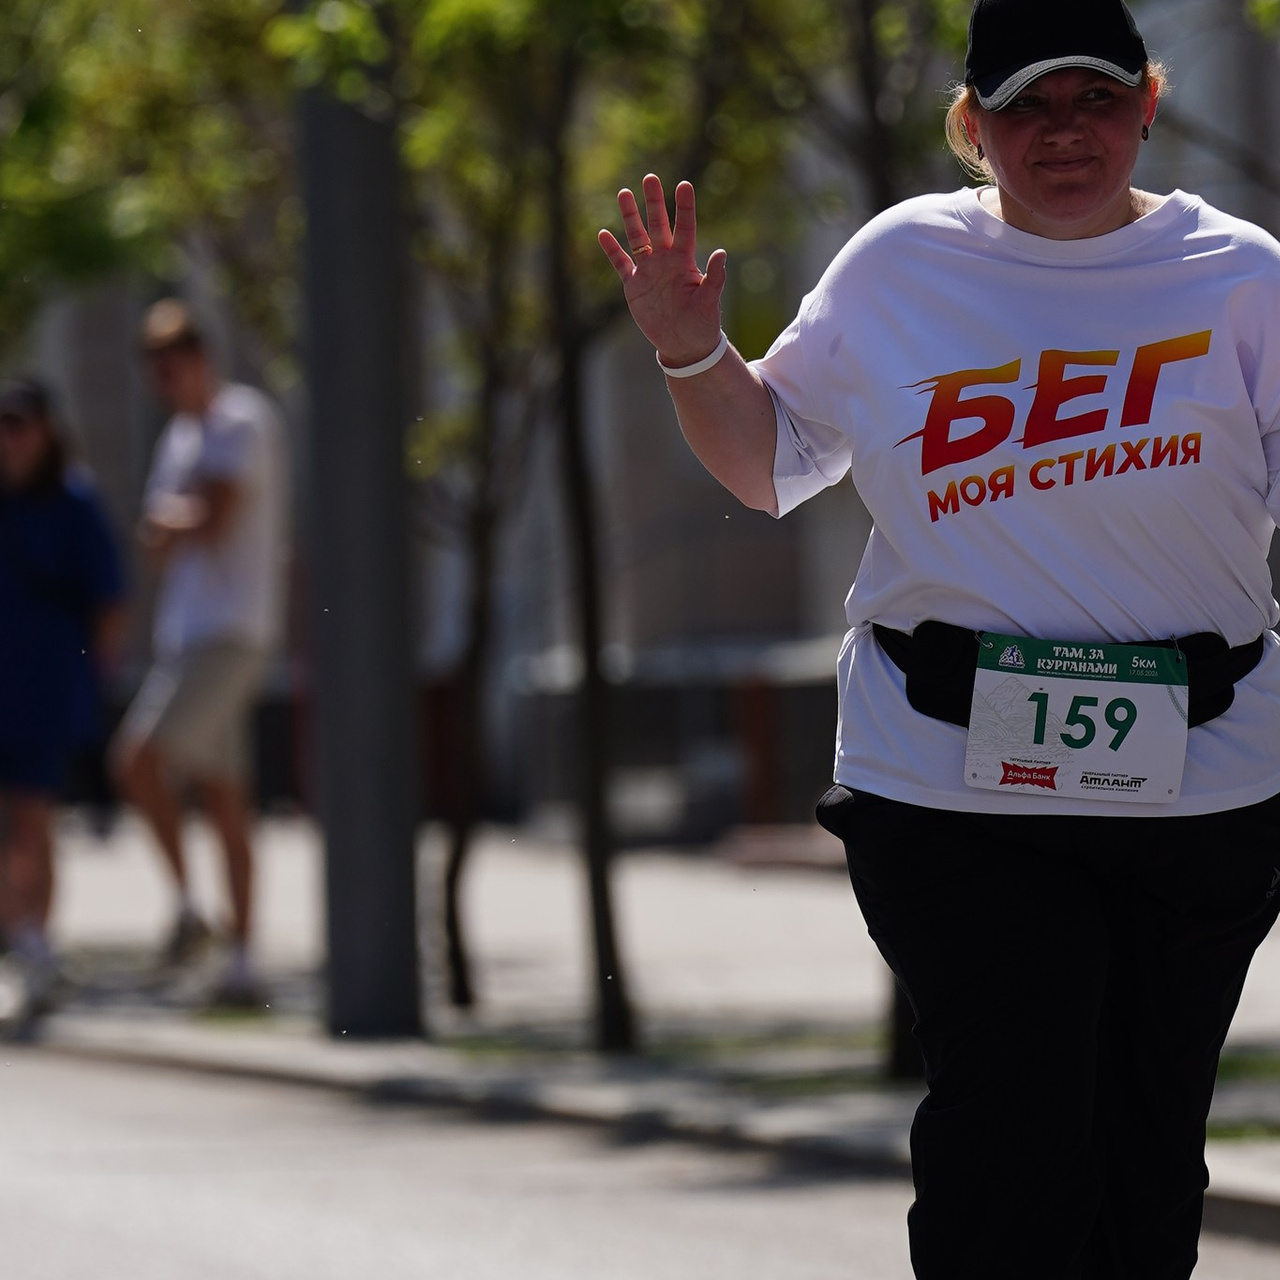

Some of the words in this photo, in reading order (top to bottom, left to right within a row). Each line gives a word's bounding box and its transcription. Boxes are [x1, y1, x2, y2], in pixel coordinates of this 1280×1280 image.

[893, 328, 1212, 476] БЕГ
[927, 464, 1015, 523] МОЯ
[1029, 431, 1202, 490] СТИХИЯ
[1036, 658, 1118, 674] КУРГАНАМИ
[1053, 646, 1086, 660] ТАМ,
[1088, 648, 1105, 660] ЗА
[1027, 692, 1138, 752] 159
[1007, 770, 1031, 780] Альфа
[1032, 772, 1051, 781] Банк
